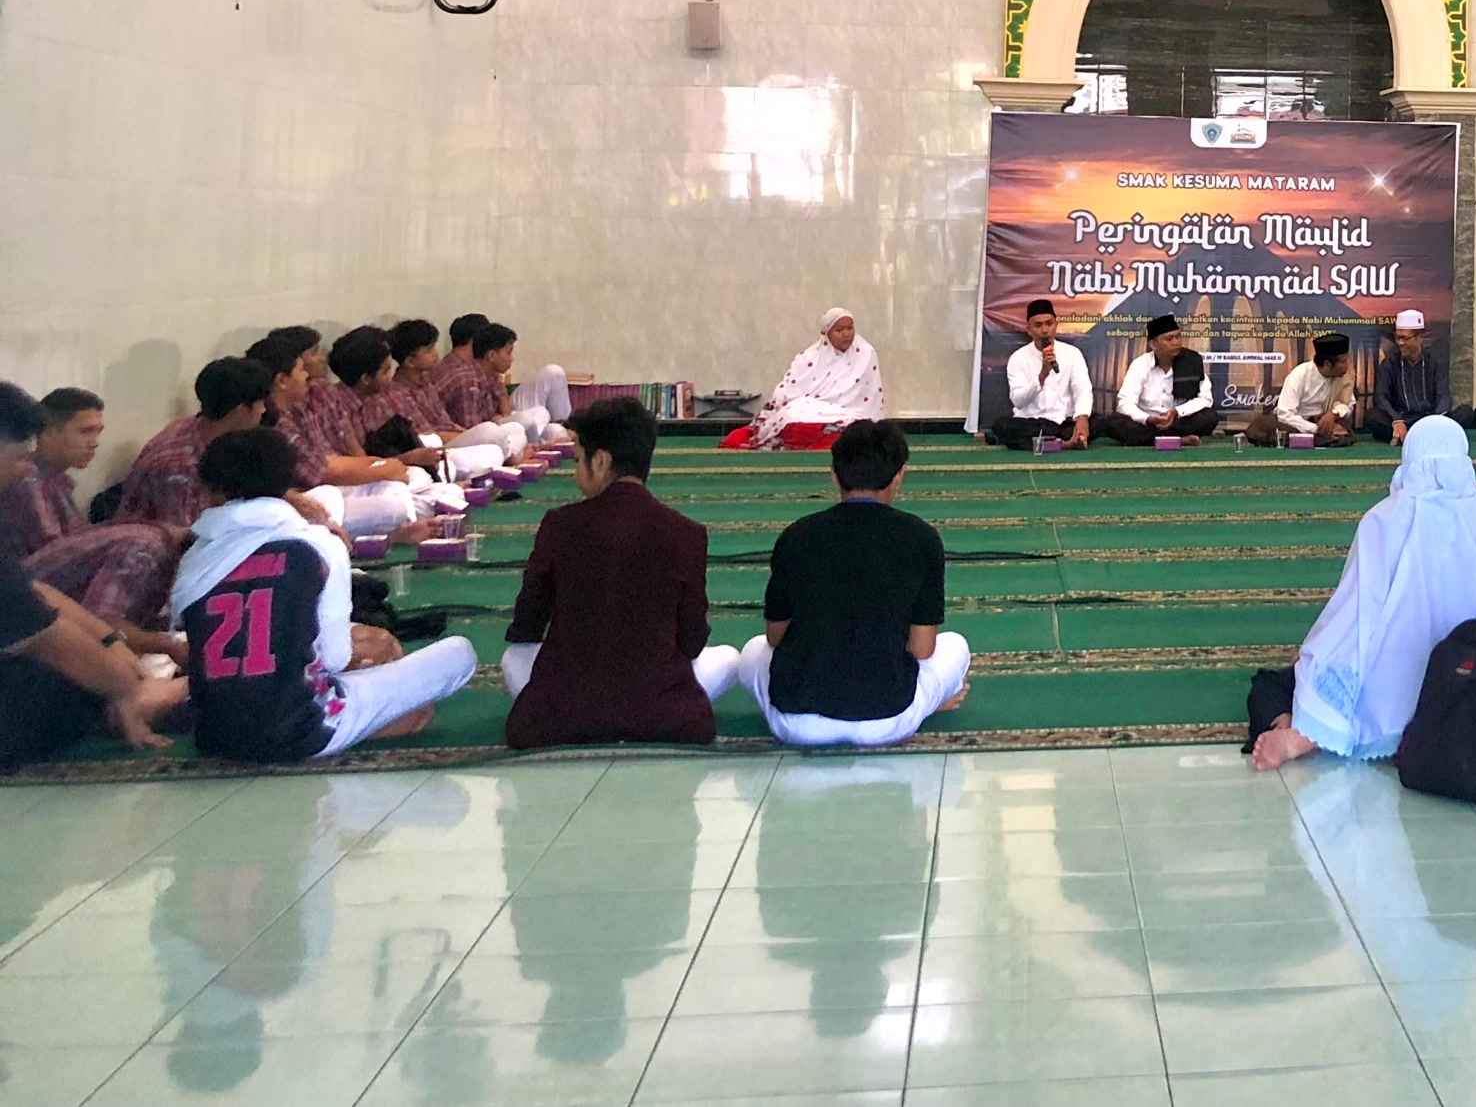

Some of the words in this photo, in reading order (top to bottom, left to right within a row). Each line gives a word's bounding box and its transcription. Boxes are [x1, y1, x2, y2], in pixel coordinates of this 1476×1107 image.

[1117, 173, 1167, 188] SMAK
[1173, 174, 1241, 189] KESUMA
[1248, 176, 1336, 191] MATARAM
[1329, 262, 1400, 299] SAW
[1055, 313, 1101, 323] eneladani
[1302, 316, 1322, 324] Nabi
[1324, 316, 1376, 325] Muhammad
[203, 587, 277, 680] 21
